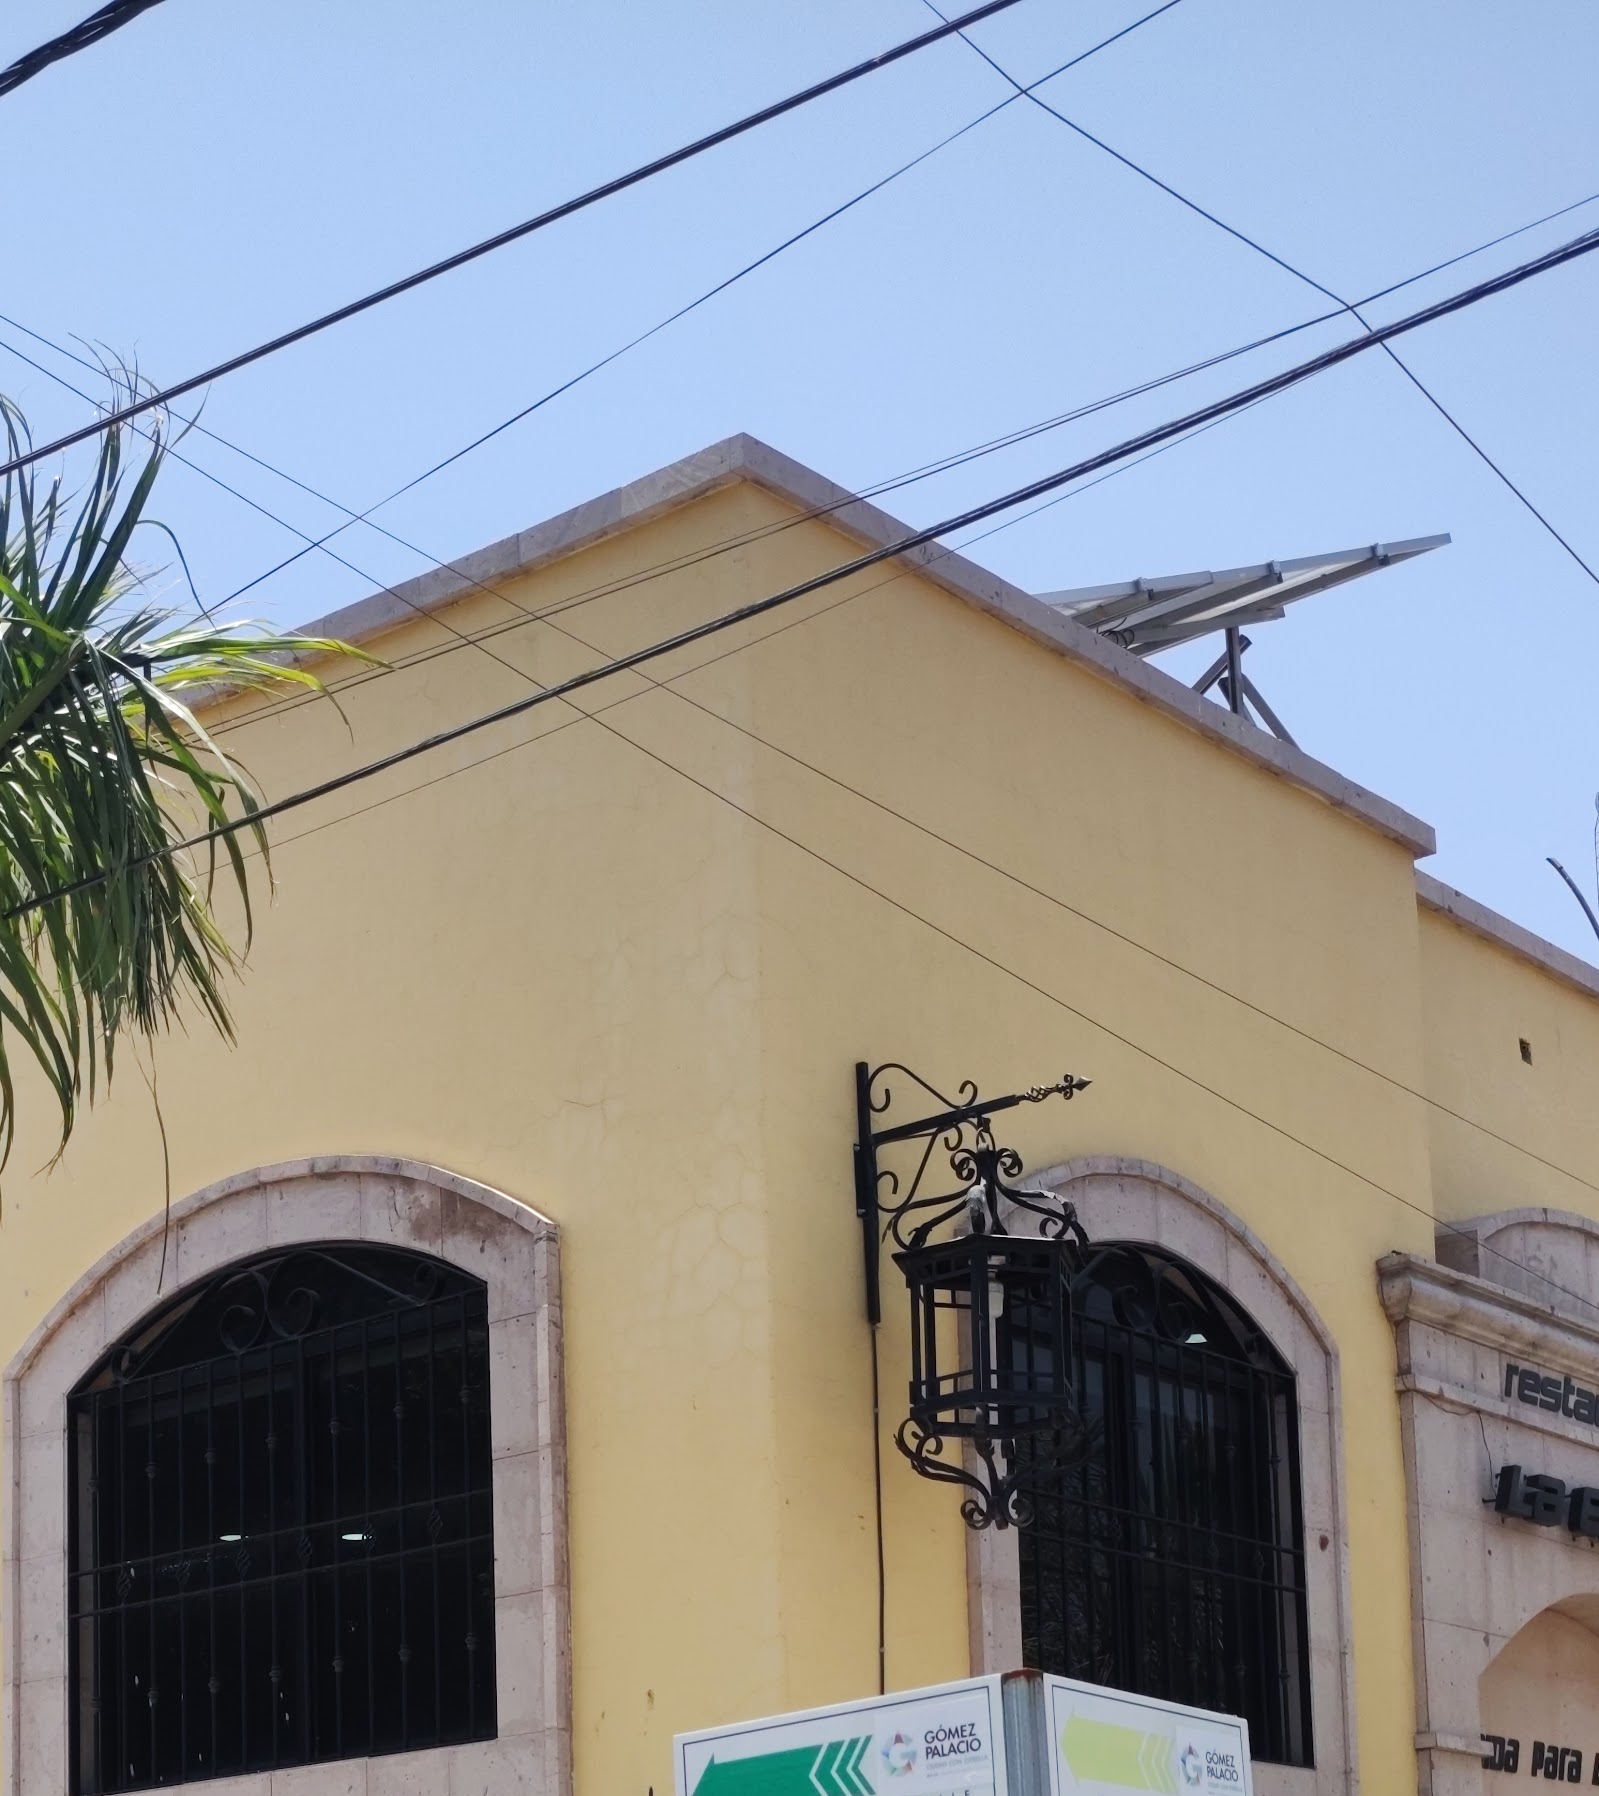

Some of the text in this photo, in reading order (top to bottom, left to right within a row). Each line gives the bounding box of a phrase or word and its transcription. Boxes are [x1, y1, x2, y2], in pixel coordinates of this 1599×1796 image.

[924, 1723, 977, 1744] GÓMEZ
[925, 1738, 982, 1760] PALACIO
[1205, 1748, 1235, 1768] GÓMEZ
[1206, 1765, 1239, 1782] PALACIO
